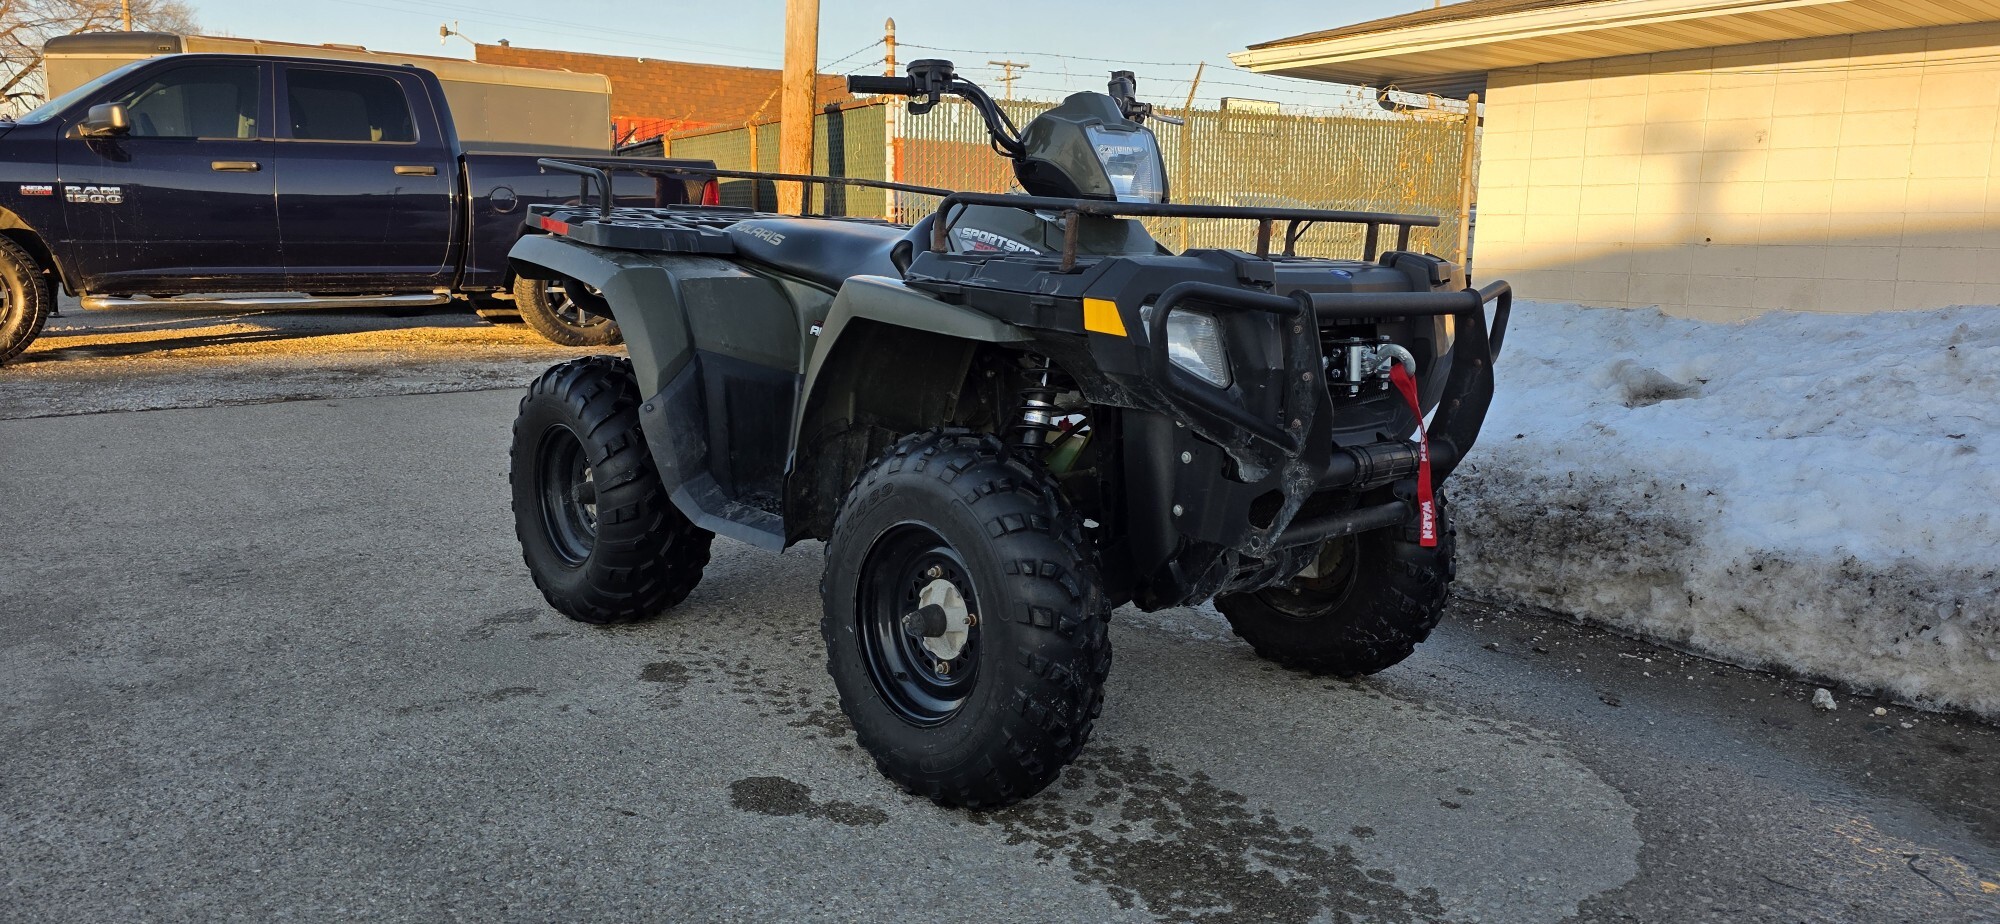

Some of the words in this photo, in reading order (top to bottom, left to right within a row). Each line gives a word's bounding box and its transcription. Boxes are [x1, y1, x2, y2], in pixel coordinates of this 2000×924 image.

[65, 186, 122, 195] RAM
[66, 194, 123, 203] 1500
[1421, 500, 1434, 539] WARN
